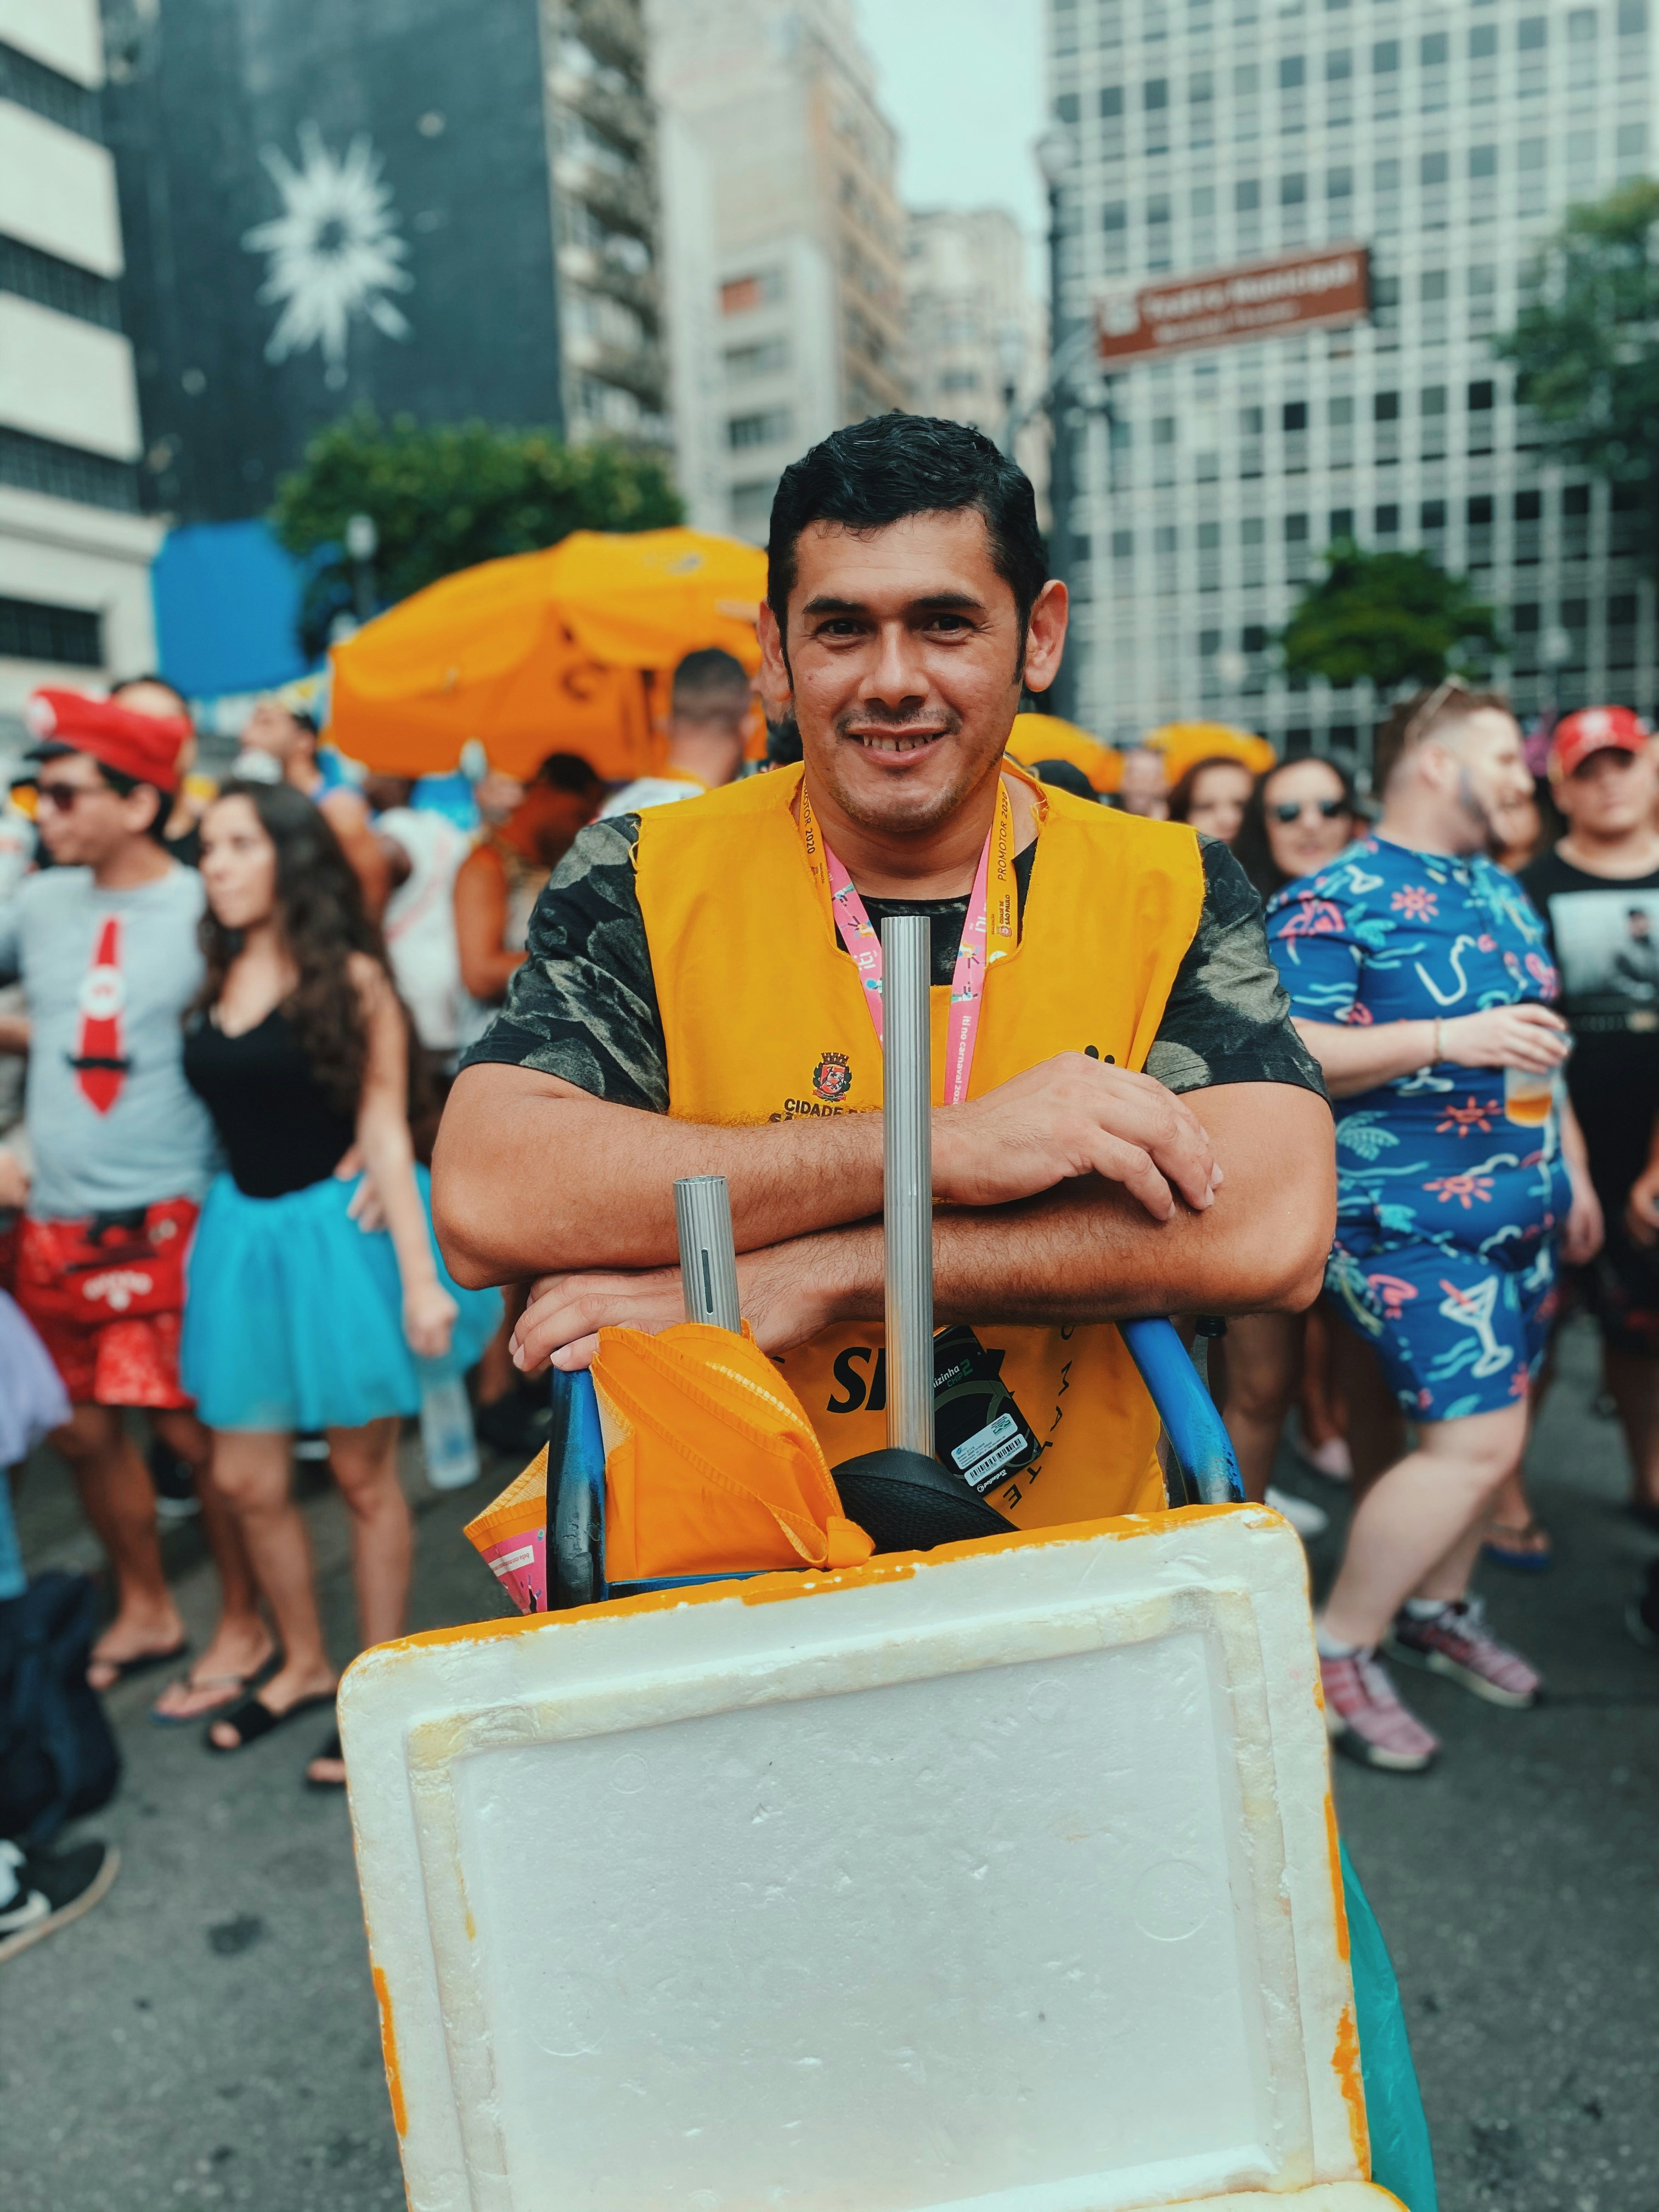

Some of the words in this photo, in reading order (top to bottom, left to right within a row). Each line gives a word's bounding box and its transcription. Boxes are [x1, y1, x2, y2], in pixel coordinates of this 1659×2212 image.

[805, 827, 816, 854] 2020
[997, 821, 1007, 882] PROMOTOR
[853, 951, 876, 971] iti
[961, 1027, 968, 1040] no
[955, 1042, 966, 1084] carnaval
[784, 1098, 844, 1117] CIDADE
[960, 1359, 973, 1376] 2
[947, 1372, 963, 1387] CHIP
